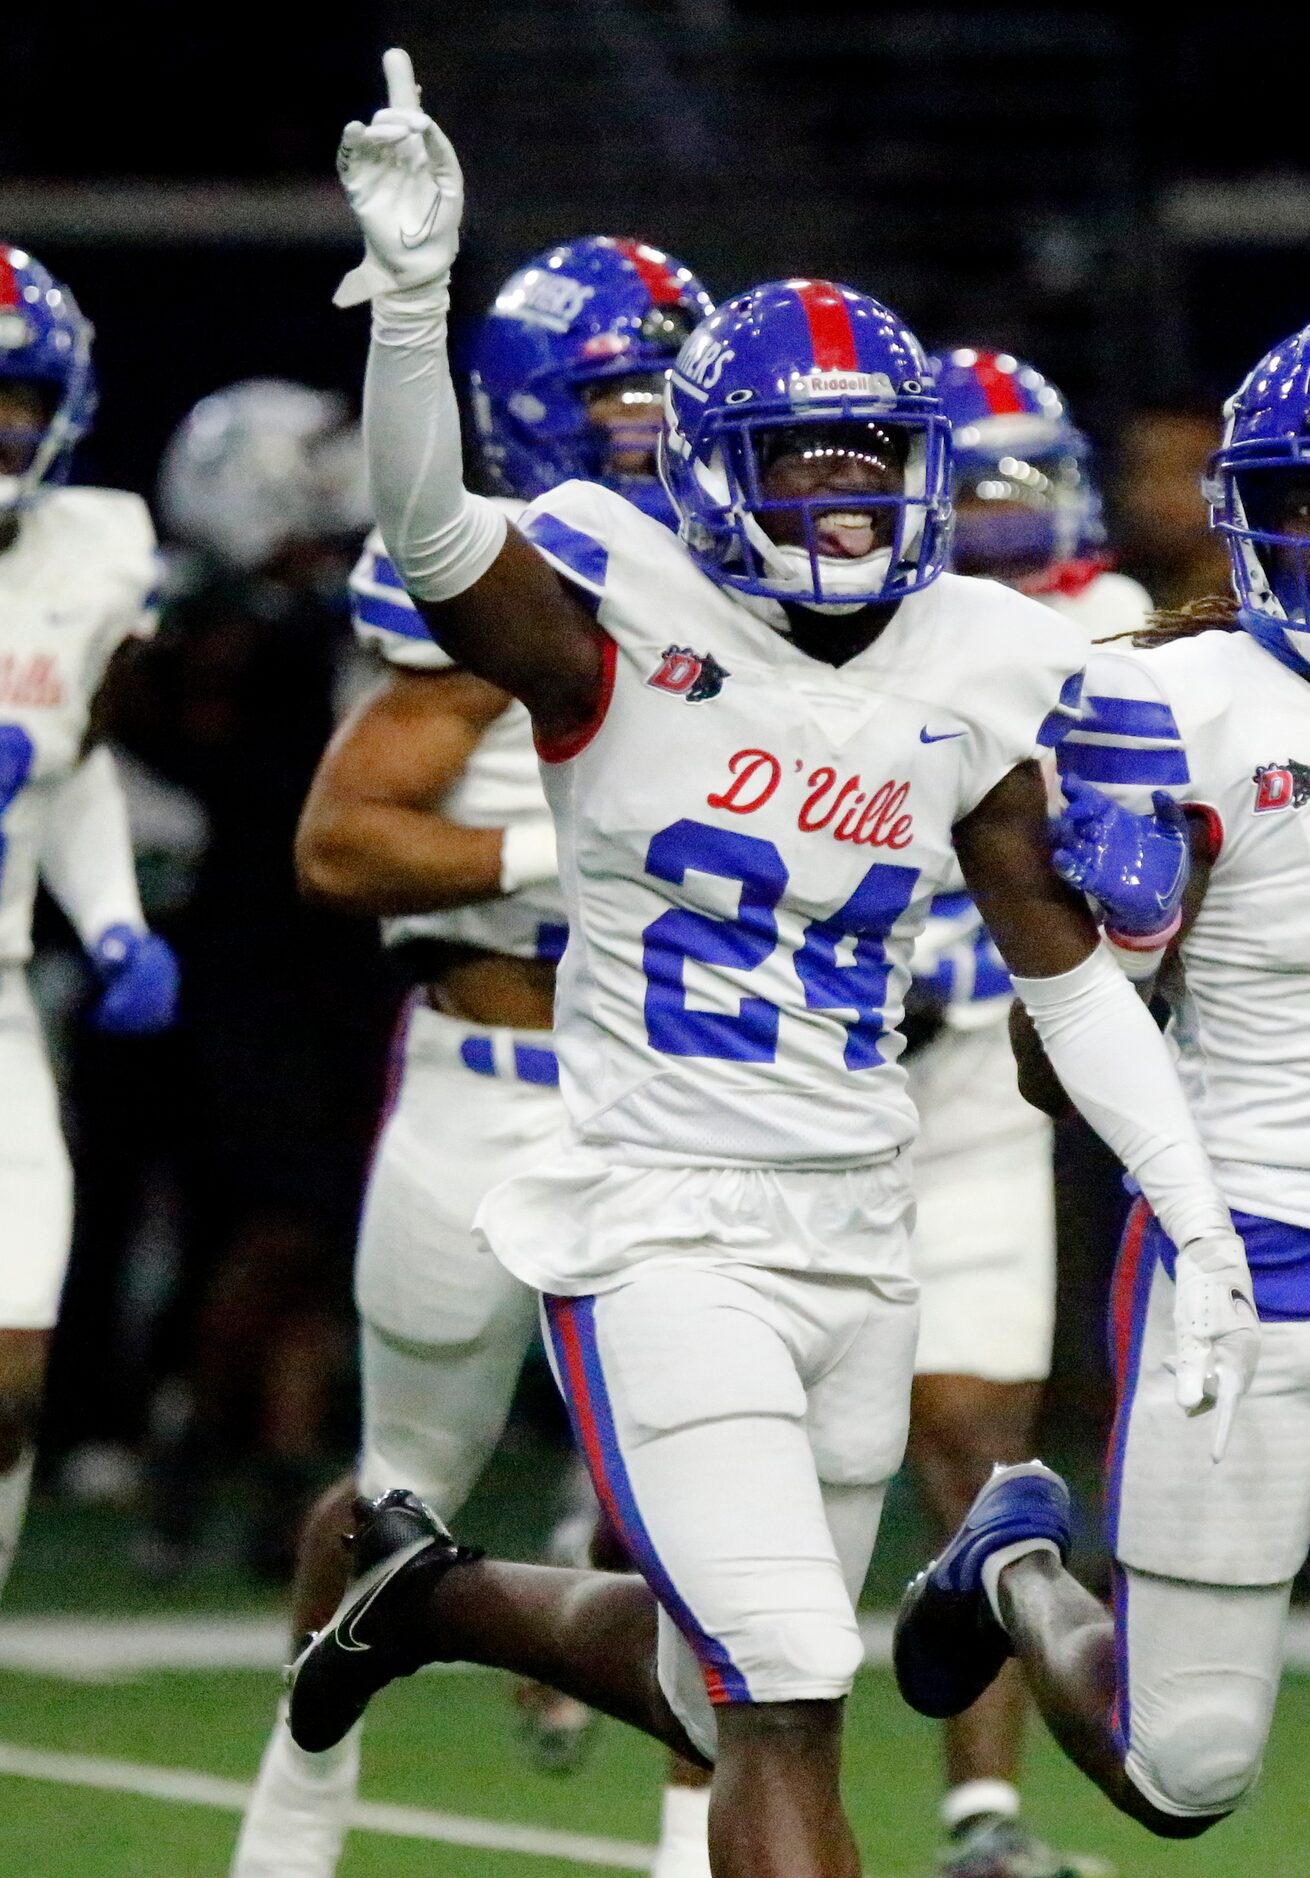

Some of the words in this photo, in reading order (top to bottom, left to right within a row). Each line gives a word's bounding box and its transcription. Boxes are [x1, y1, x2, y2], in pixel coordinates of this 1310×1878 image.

[810, 376, 867, 391] Riddell
[706, 748, 914, 850] D'Ville
[642, 817, 923, 1072] 24
